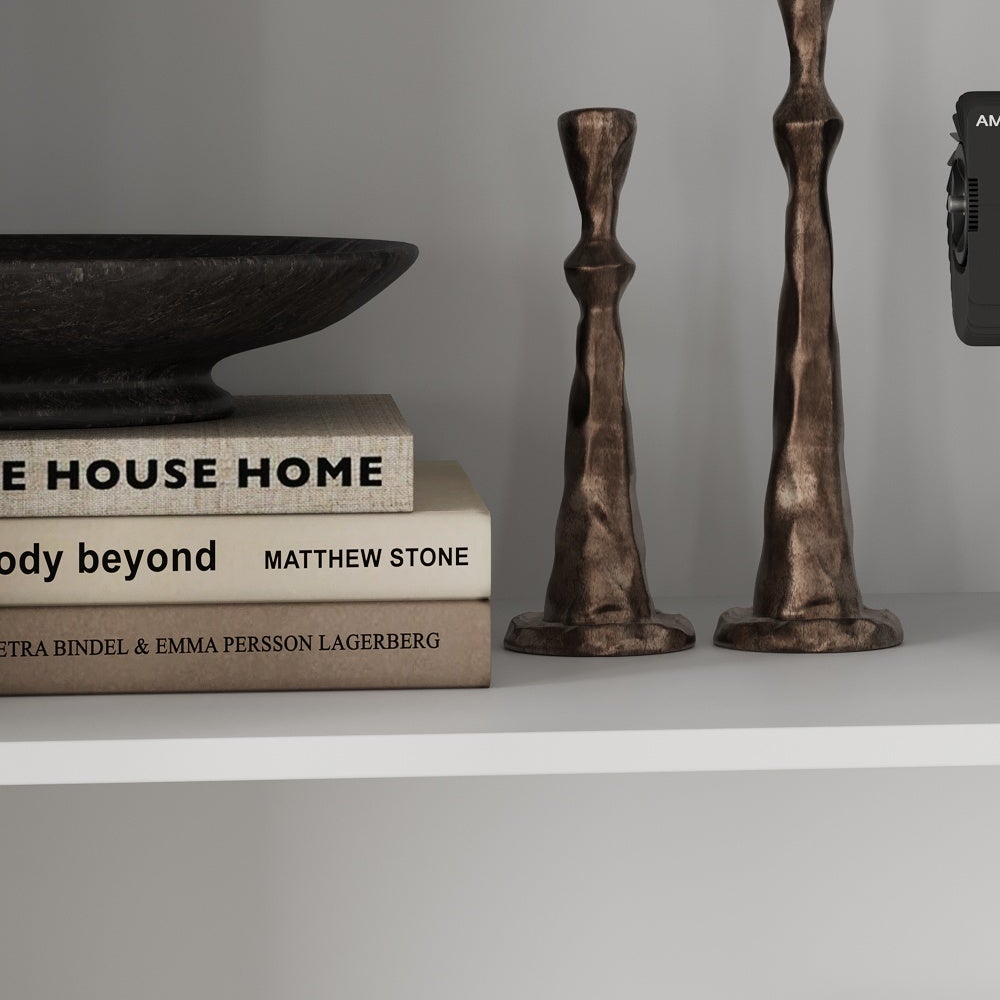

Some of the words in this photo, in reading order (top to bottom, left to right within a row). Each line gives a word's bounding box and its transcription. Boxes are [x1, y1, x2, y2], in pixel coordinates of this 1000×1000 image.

[48, 458, 217, 491] HOUSE
[238, 456, 383, 488] HOME
[78, 540, 216, 581] beyond
[264, 548, 383, 570] MATTHEW
[390, 547, 469, 568] STONE
[54, 638, 129, 657] BINDEL
[134, 638, 150, 655] &
[156, 637, 219, 654] EMMA
[223, 635, 314, 653] PERSSON
[318, 632, 441, 652] LAGERBERG
